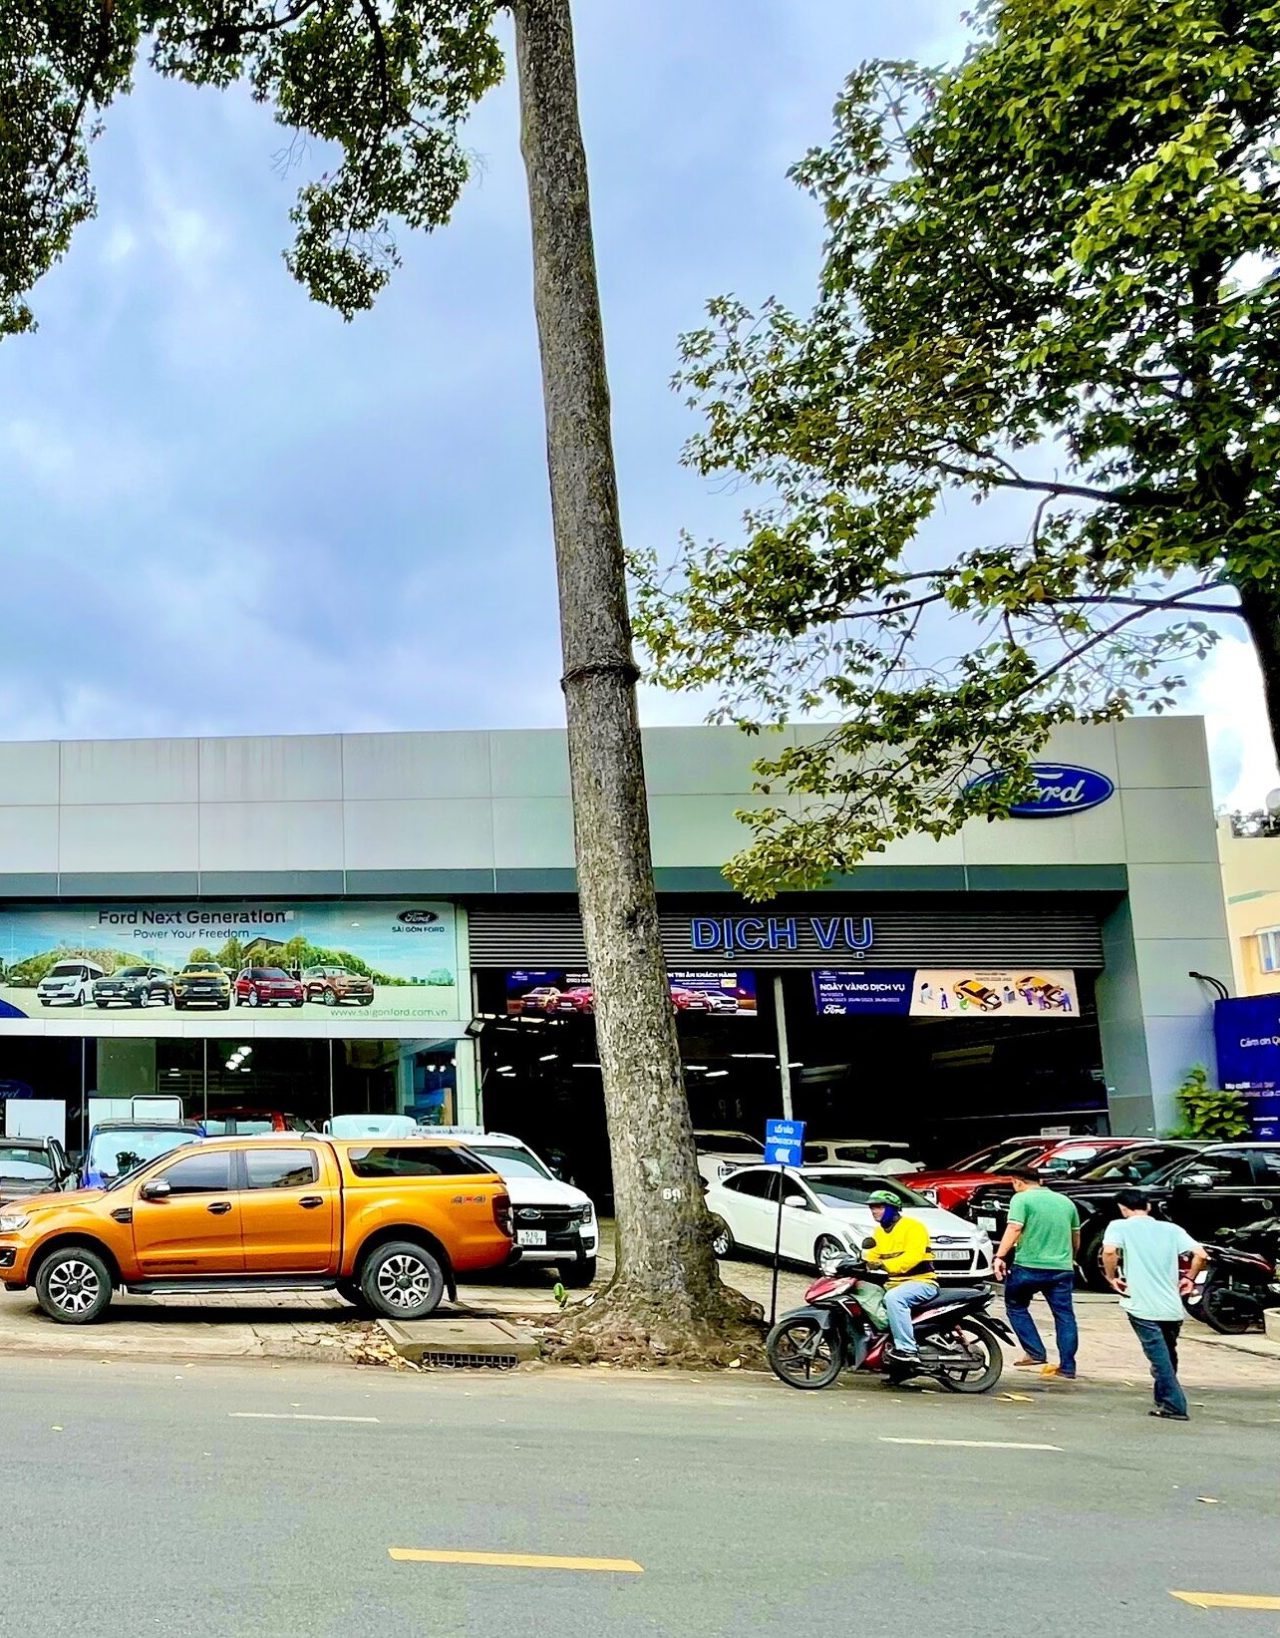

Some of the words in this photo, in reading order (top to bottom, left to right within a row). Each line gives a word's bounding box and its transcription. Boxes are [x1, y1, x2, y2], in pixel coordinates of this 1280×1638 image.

[97, 910, 138, 924] Ford
[142, 911, 182, 924] Next
[186, 909, 286, 924] Generation
[133, 929, 168, 939] Power
[171, 929, 196, 939] Your
[199, 928, 250, 939] Freedom
[691, 917, 798, 959] DỊCH
[810, 917, 873, 959] VỤ
[819, 982, 843, 991] NGÀY
[844, 982, 869, 991] VÀNG
[870, 983, 891, 992] DỊCH
[892, 983, 906, 992] VỤ
[330, 1008, 449, 1018] www.saigonford.com.vn
[823, 1004, 847, 1015] Ford
